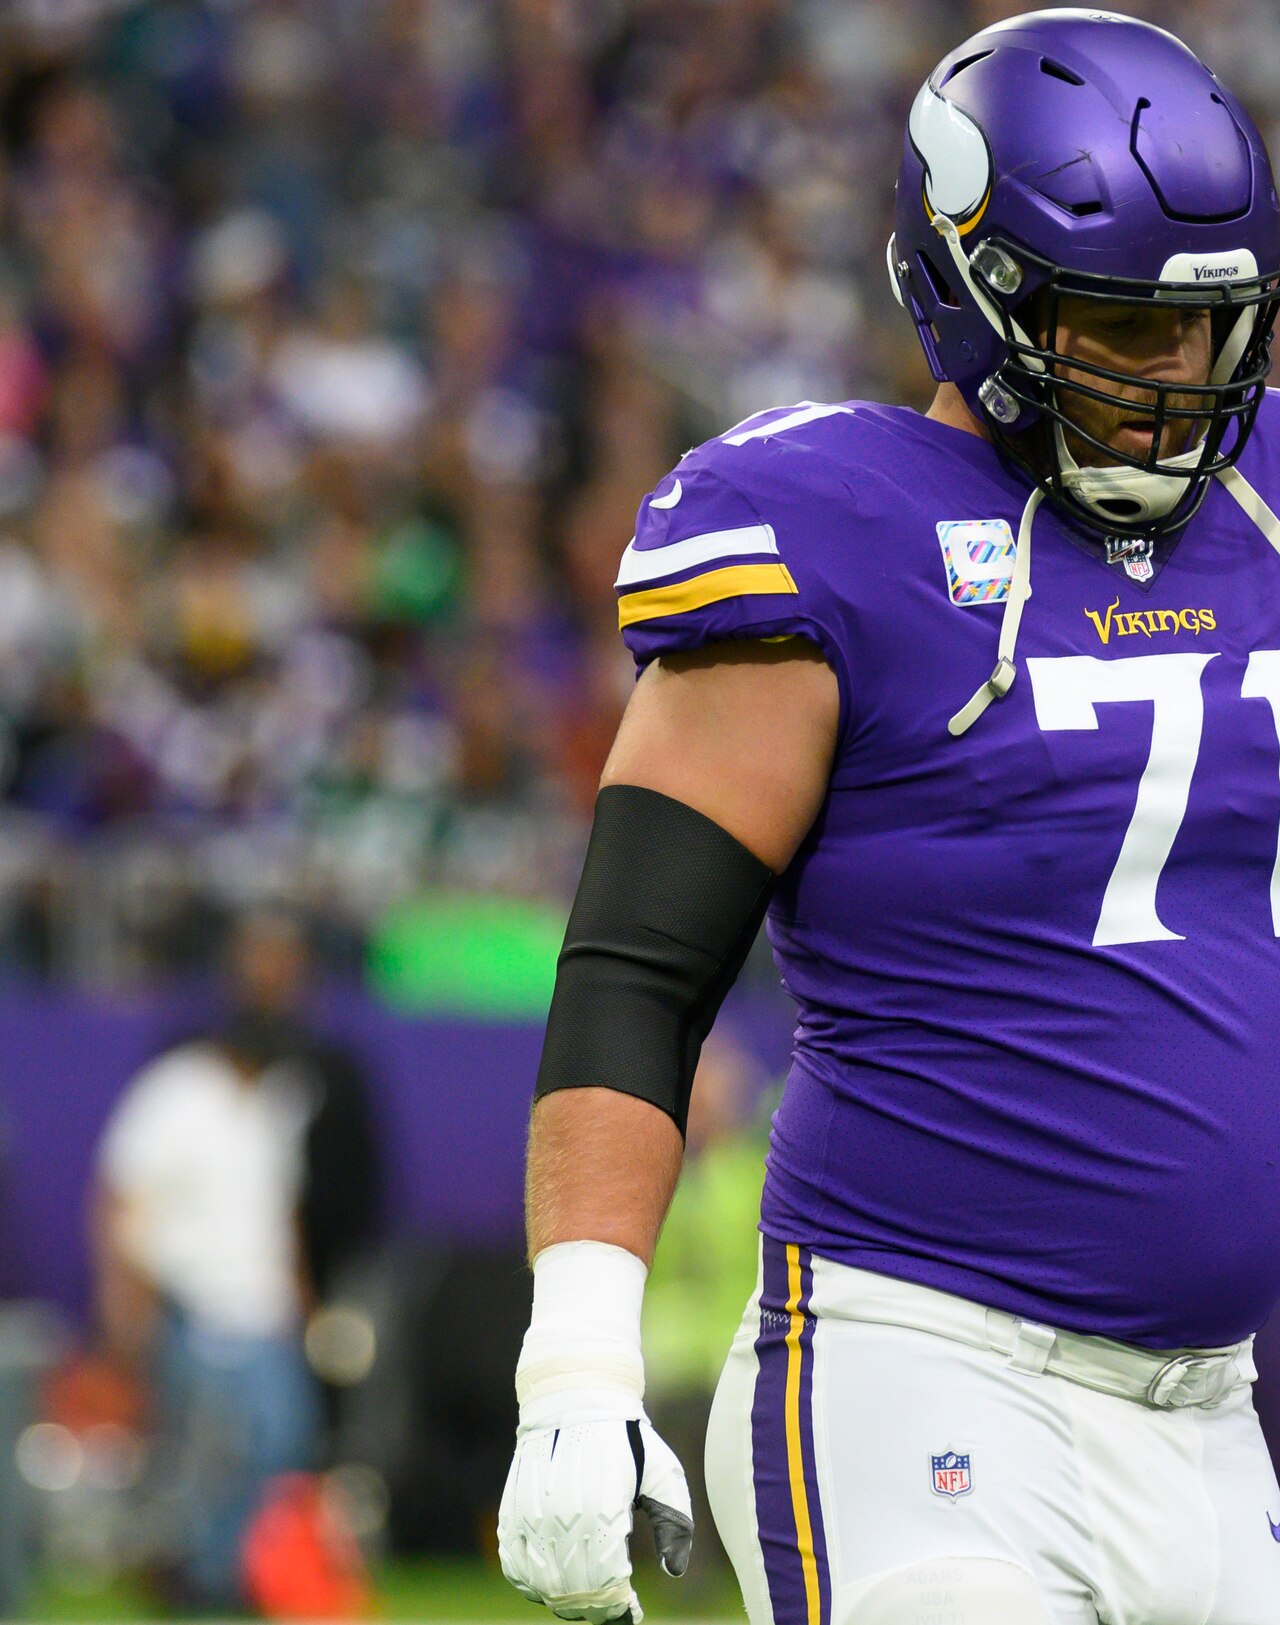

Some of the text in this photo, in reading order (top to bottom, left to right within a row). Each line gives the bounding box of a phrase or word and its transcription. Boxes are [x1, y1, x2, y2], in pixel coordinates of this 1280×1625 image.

[1130, 562, 1149, 575] NFL
[1084, 595, 1217, 645] VIKINGS
[936, 1470, 969, 1492] NFL
[906, 1568, 963, 1585] ADAMS
[920, 1591, 955, 1606] USA
